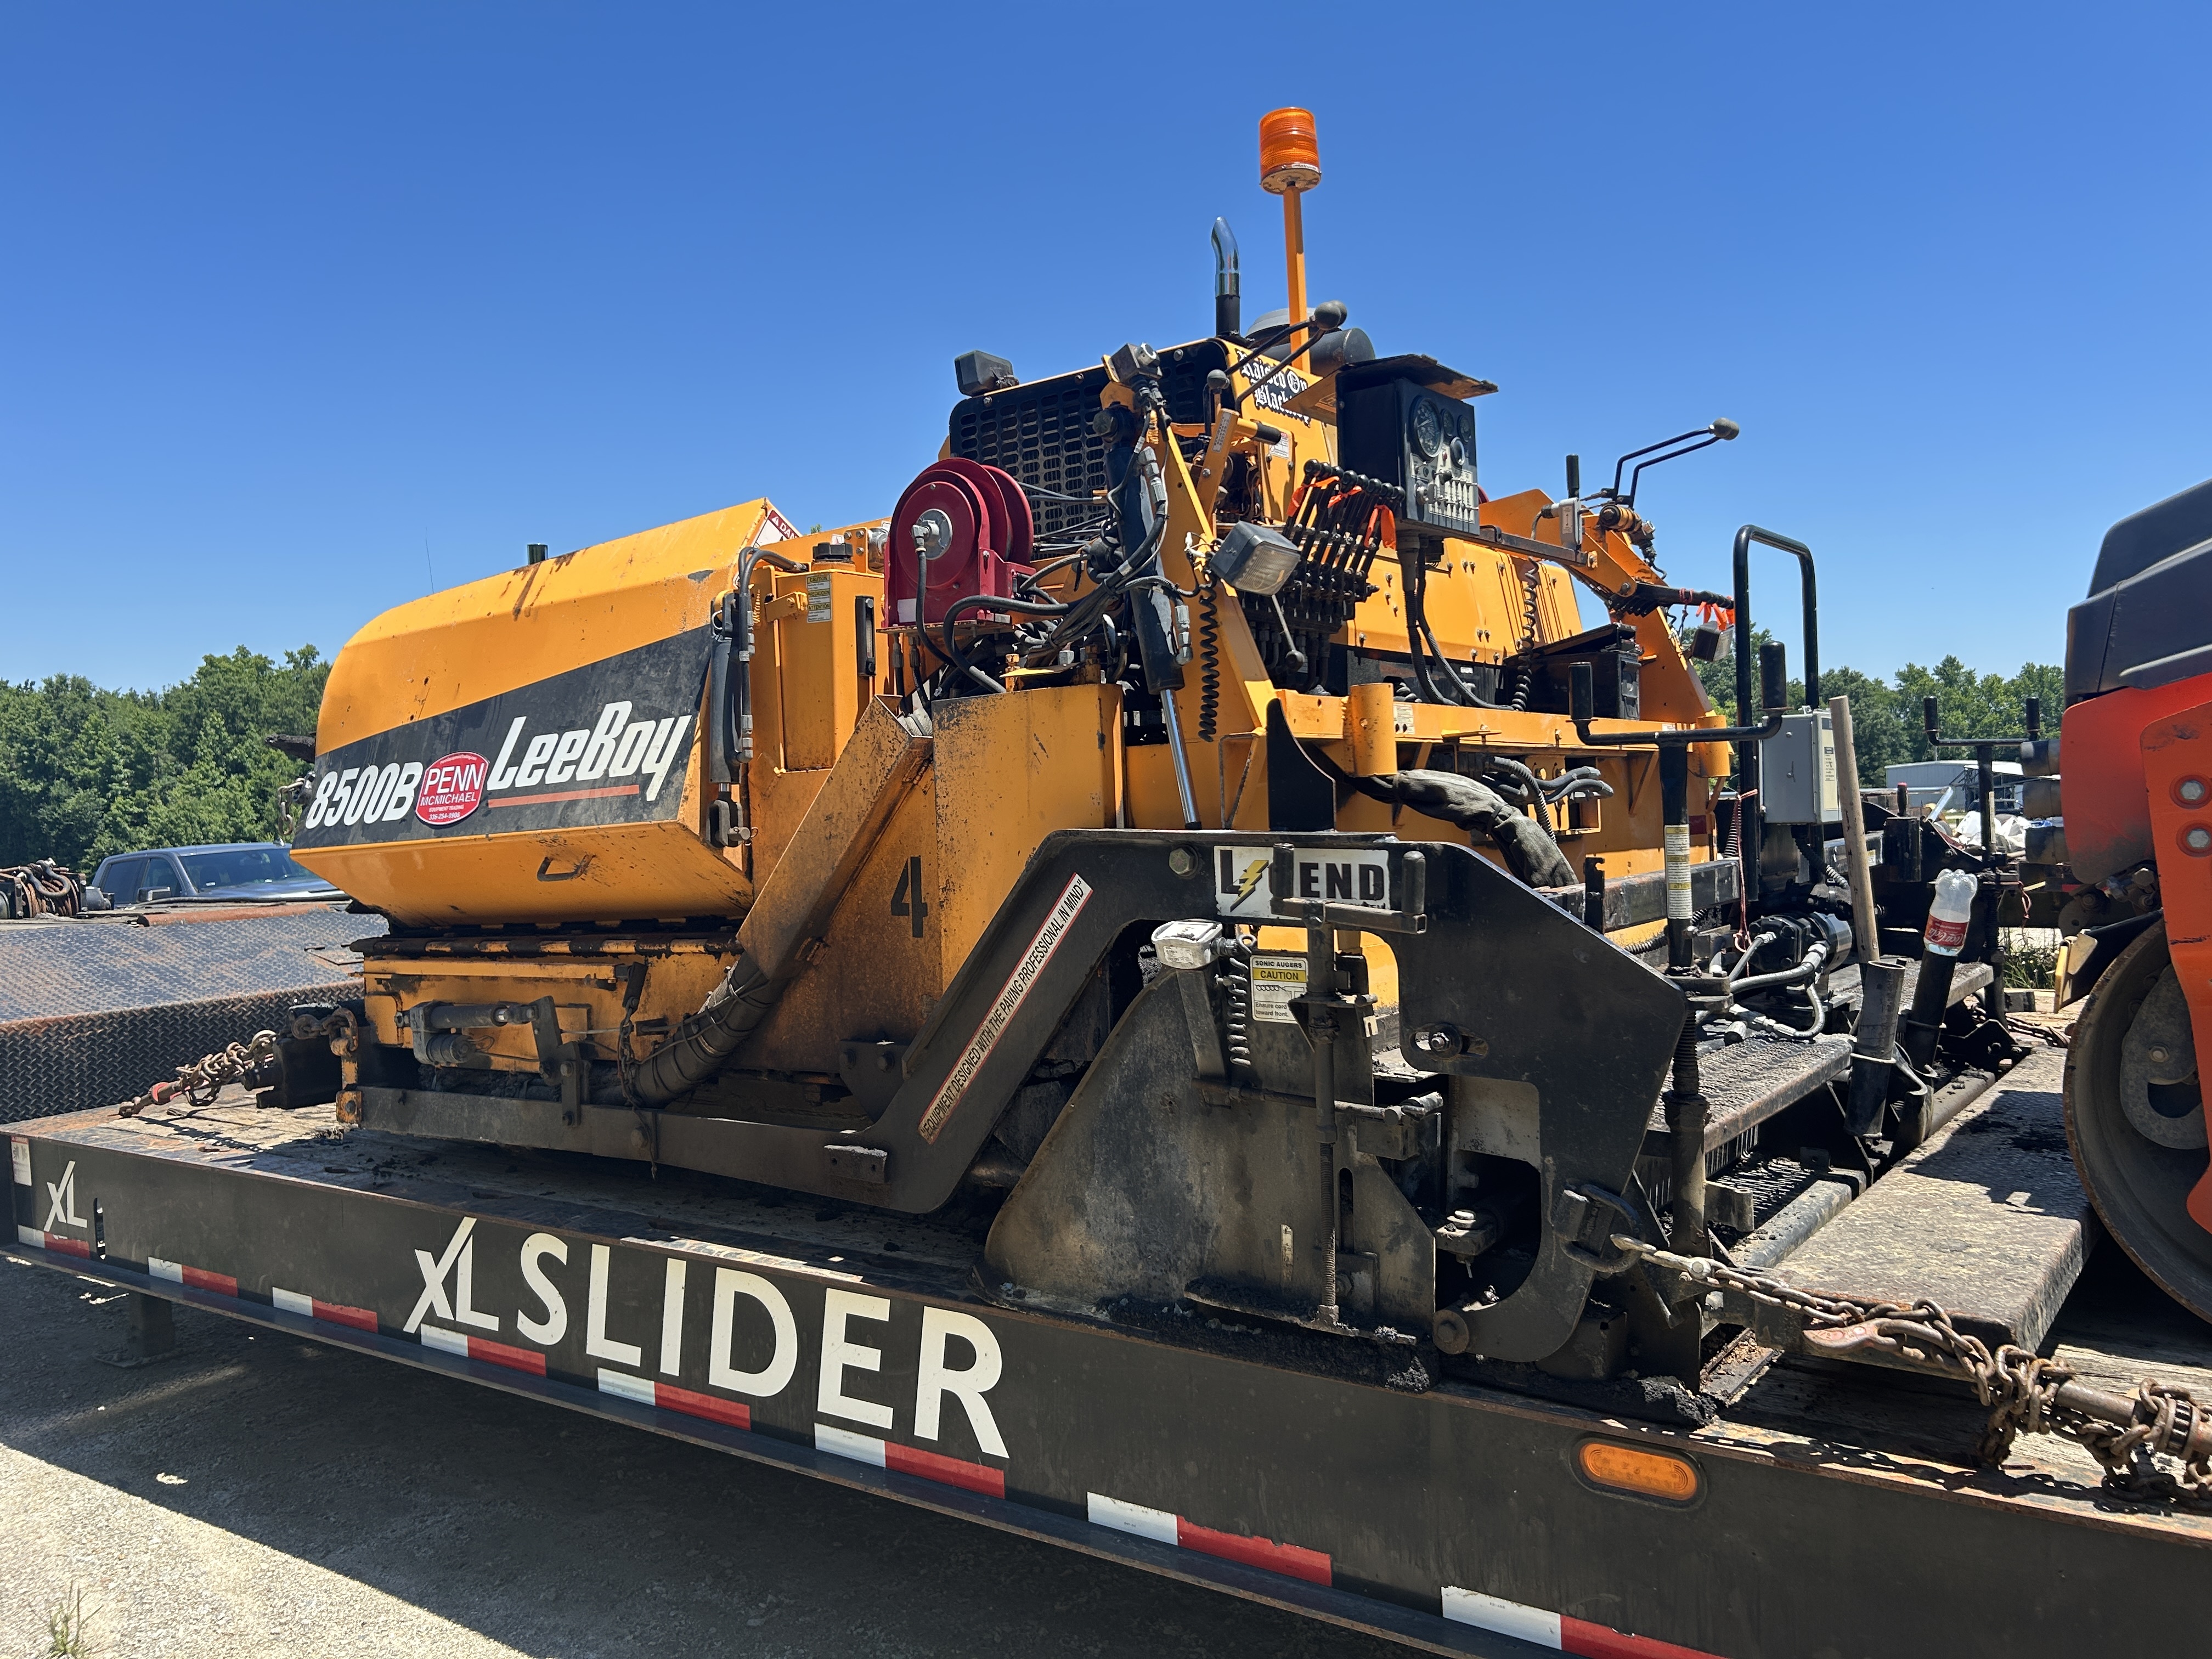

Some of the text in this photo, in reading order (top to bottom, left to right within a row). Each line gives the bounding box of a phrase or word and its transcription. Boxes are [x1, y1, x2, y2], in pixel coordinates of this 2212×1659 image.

[1287, 370, 1308, 394] On
[424, 763, 485, 795] PENN
[487, 701, 692, 802] LeeBoy
[305, 761, 423, 830] 8500B
[420, 792, 477, 806] MCMICHAEL
[891, 856, 928, 938] 4
[951, 1046, 981, 1093] DESIGNED
[975, 1025, 996, 1053] WITH
[989, 1008, 1006, 1032] THE
[1000, 980, 1024, 1016] PAVING
[1018, 917, 1064, 986] PROFESSIONAL
[1057, 905, 1070, 923] IN
[1260, 970, 1299, 980] CAUTION
[43, 1160, 87, 1232] XL
[403, 1216, 1010, 1459] XL SLIDER
